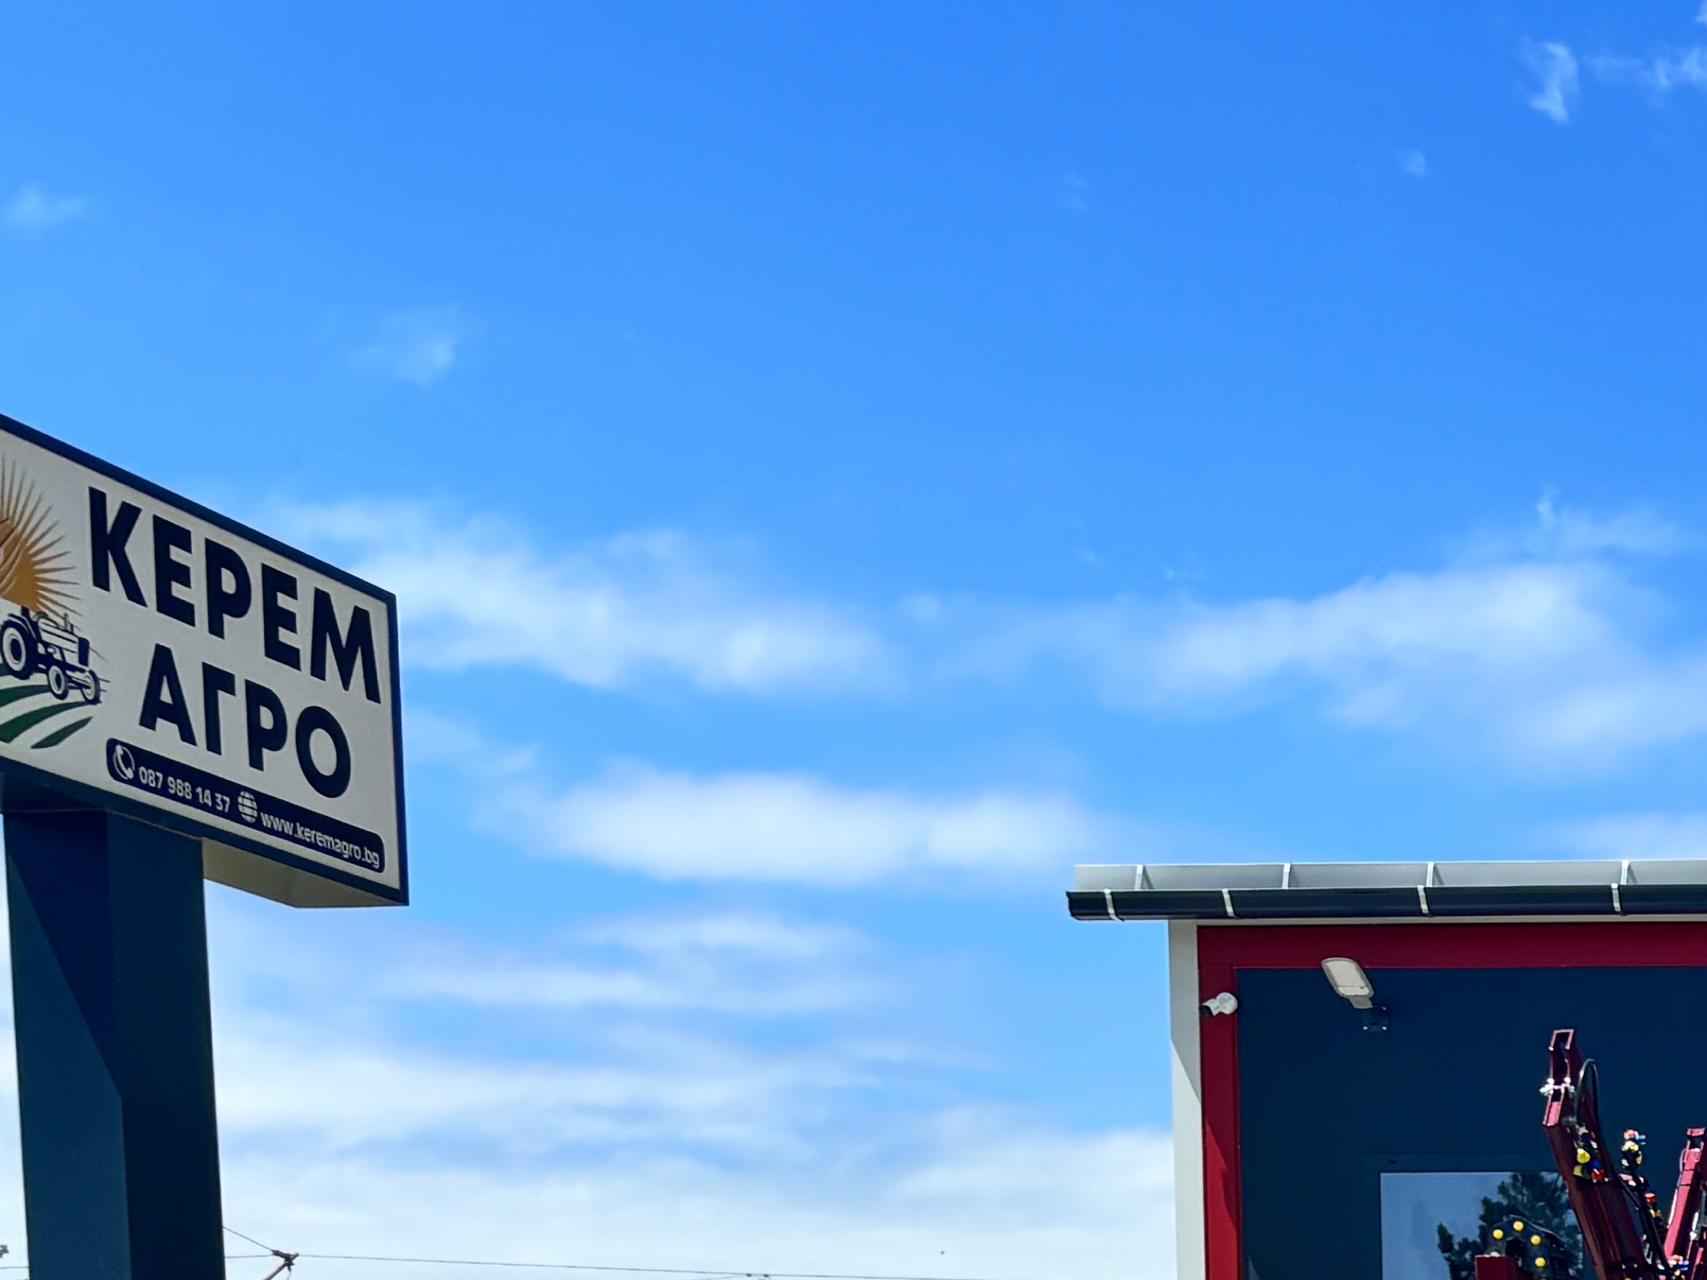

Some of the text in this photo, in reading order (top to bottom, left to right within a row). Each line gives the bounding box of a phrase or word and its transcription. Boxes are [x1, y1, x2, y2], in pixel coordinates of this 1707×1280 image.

[88, 486, 382, 704] КЕРЕМ
[139, 643, 352, 799] АГРО
[138, 766, 381, 870] 087 988 14 37 www.keremagro.bg
